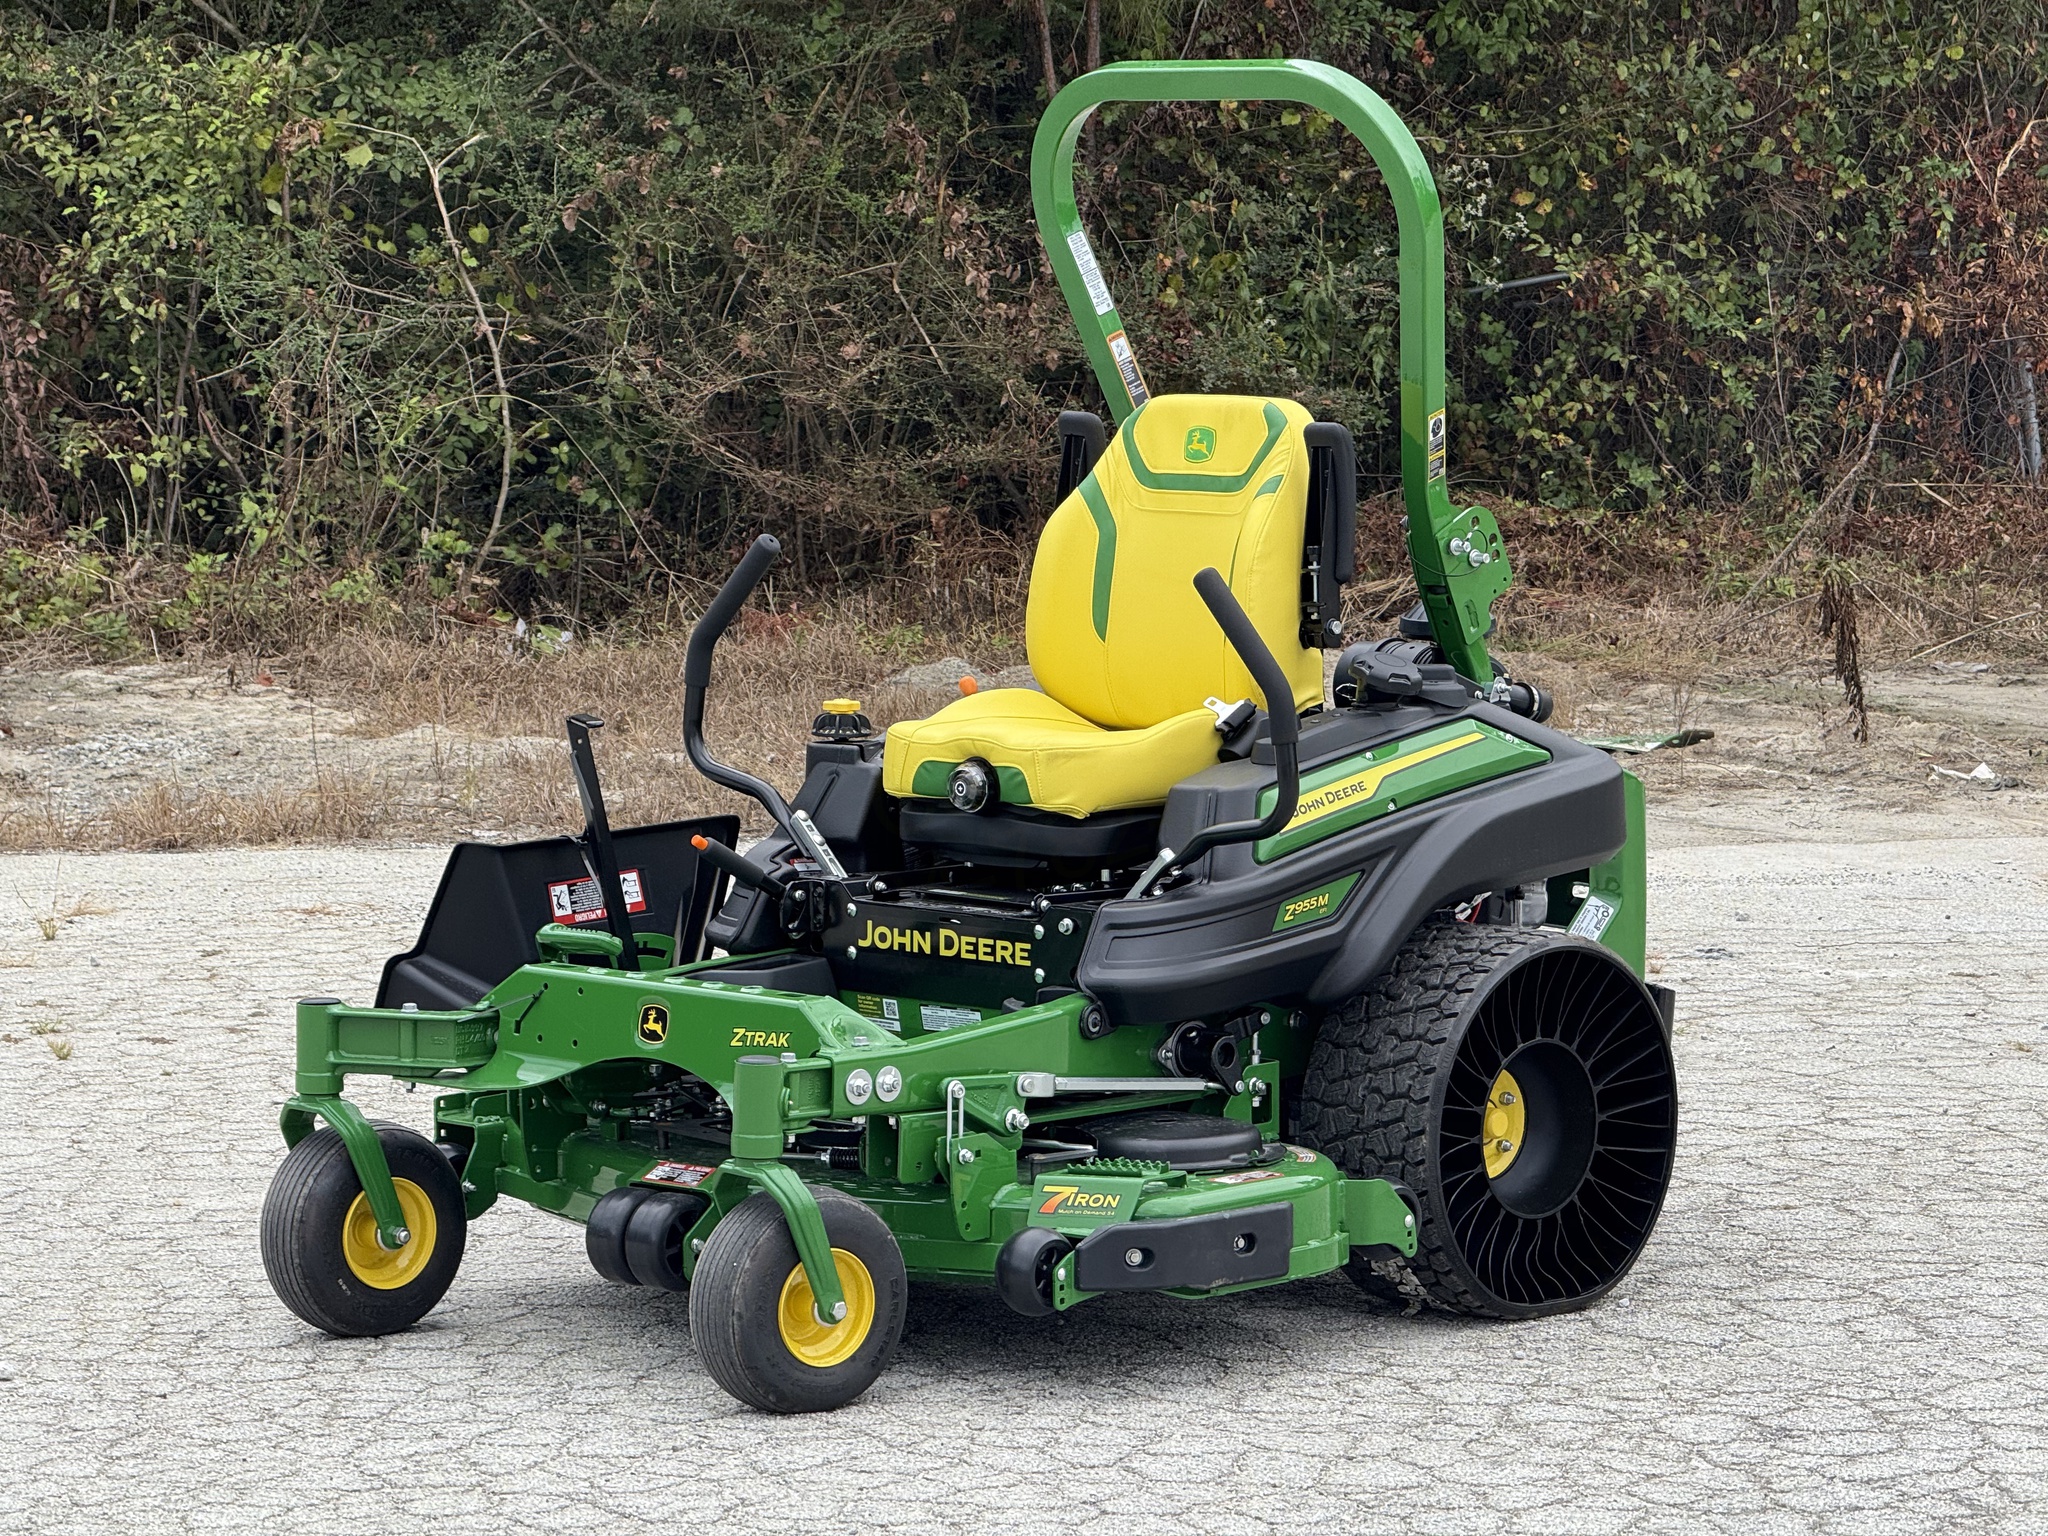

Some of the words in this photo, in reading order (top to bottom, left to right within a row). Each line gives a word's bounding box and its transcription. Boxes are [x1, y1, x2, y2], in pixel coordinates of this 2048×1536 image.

[1325, 780, 1367, 804] DEERE
[1283, 892, 1330, 922] Z955M
[857, 919, 931, 955] JOHN
[939, 928, 1032, 967] DEERE
[730, 1027, 791, 1048] ZTRAK
